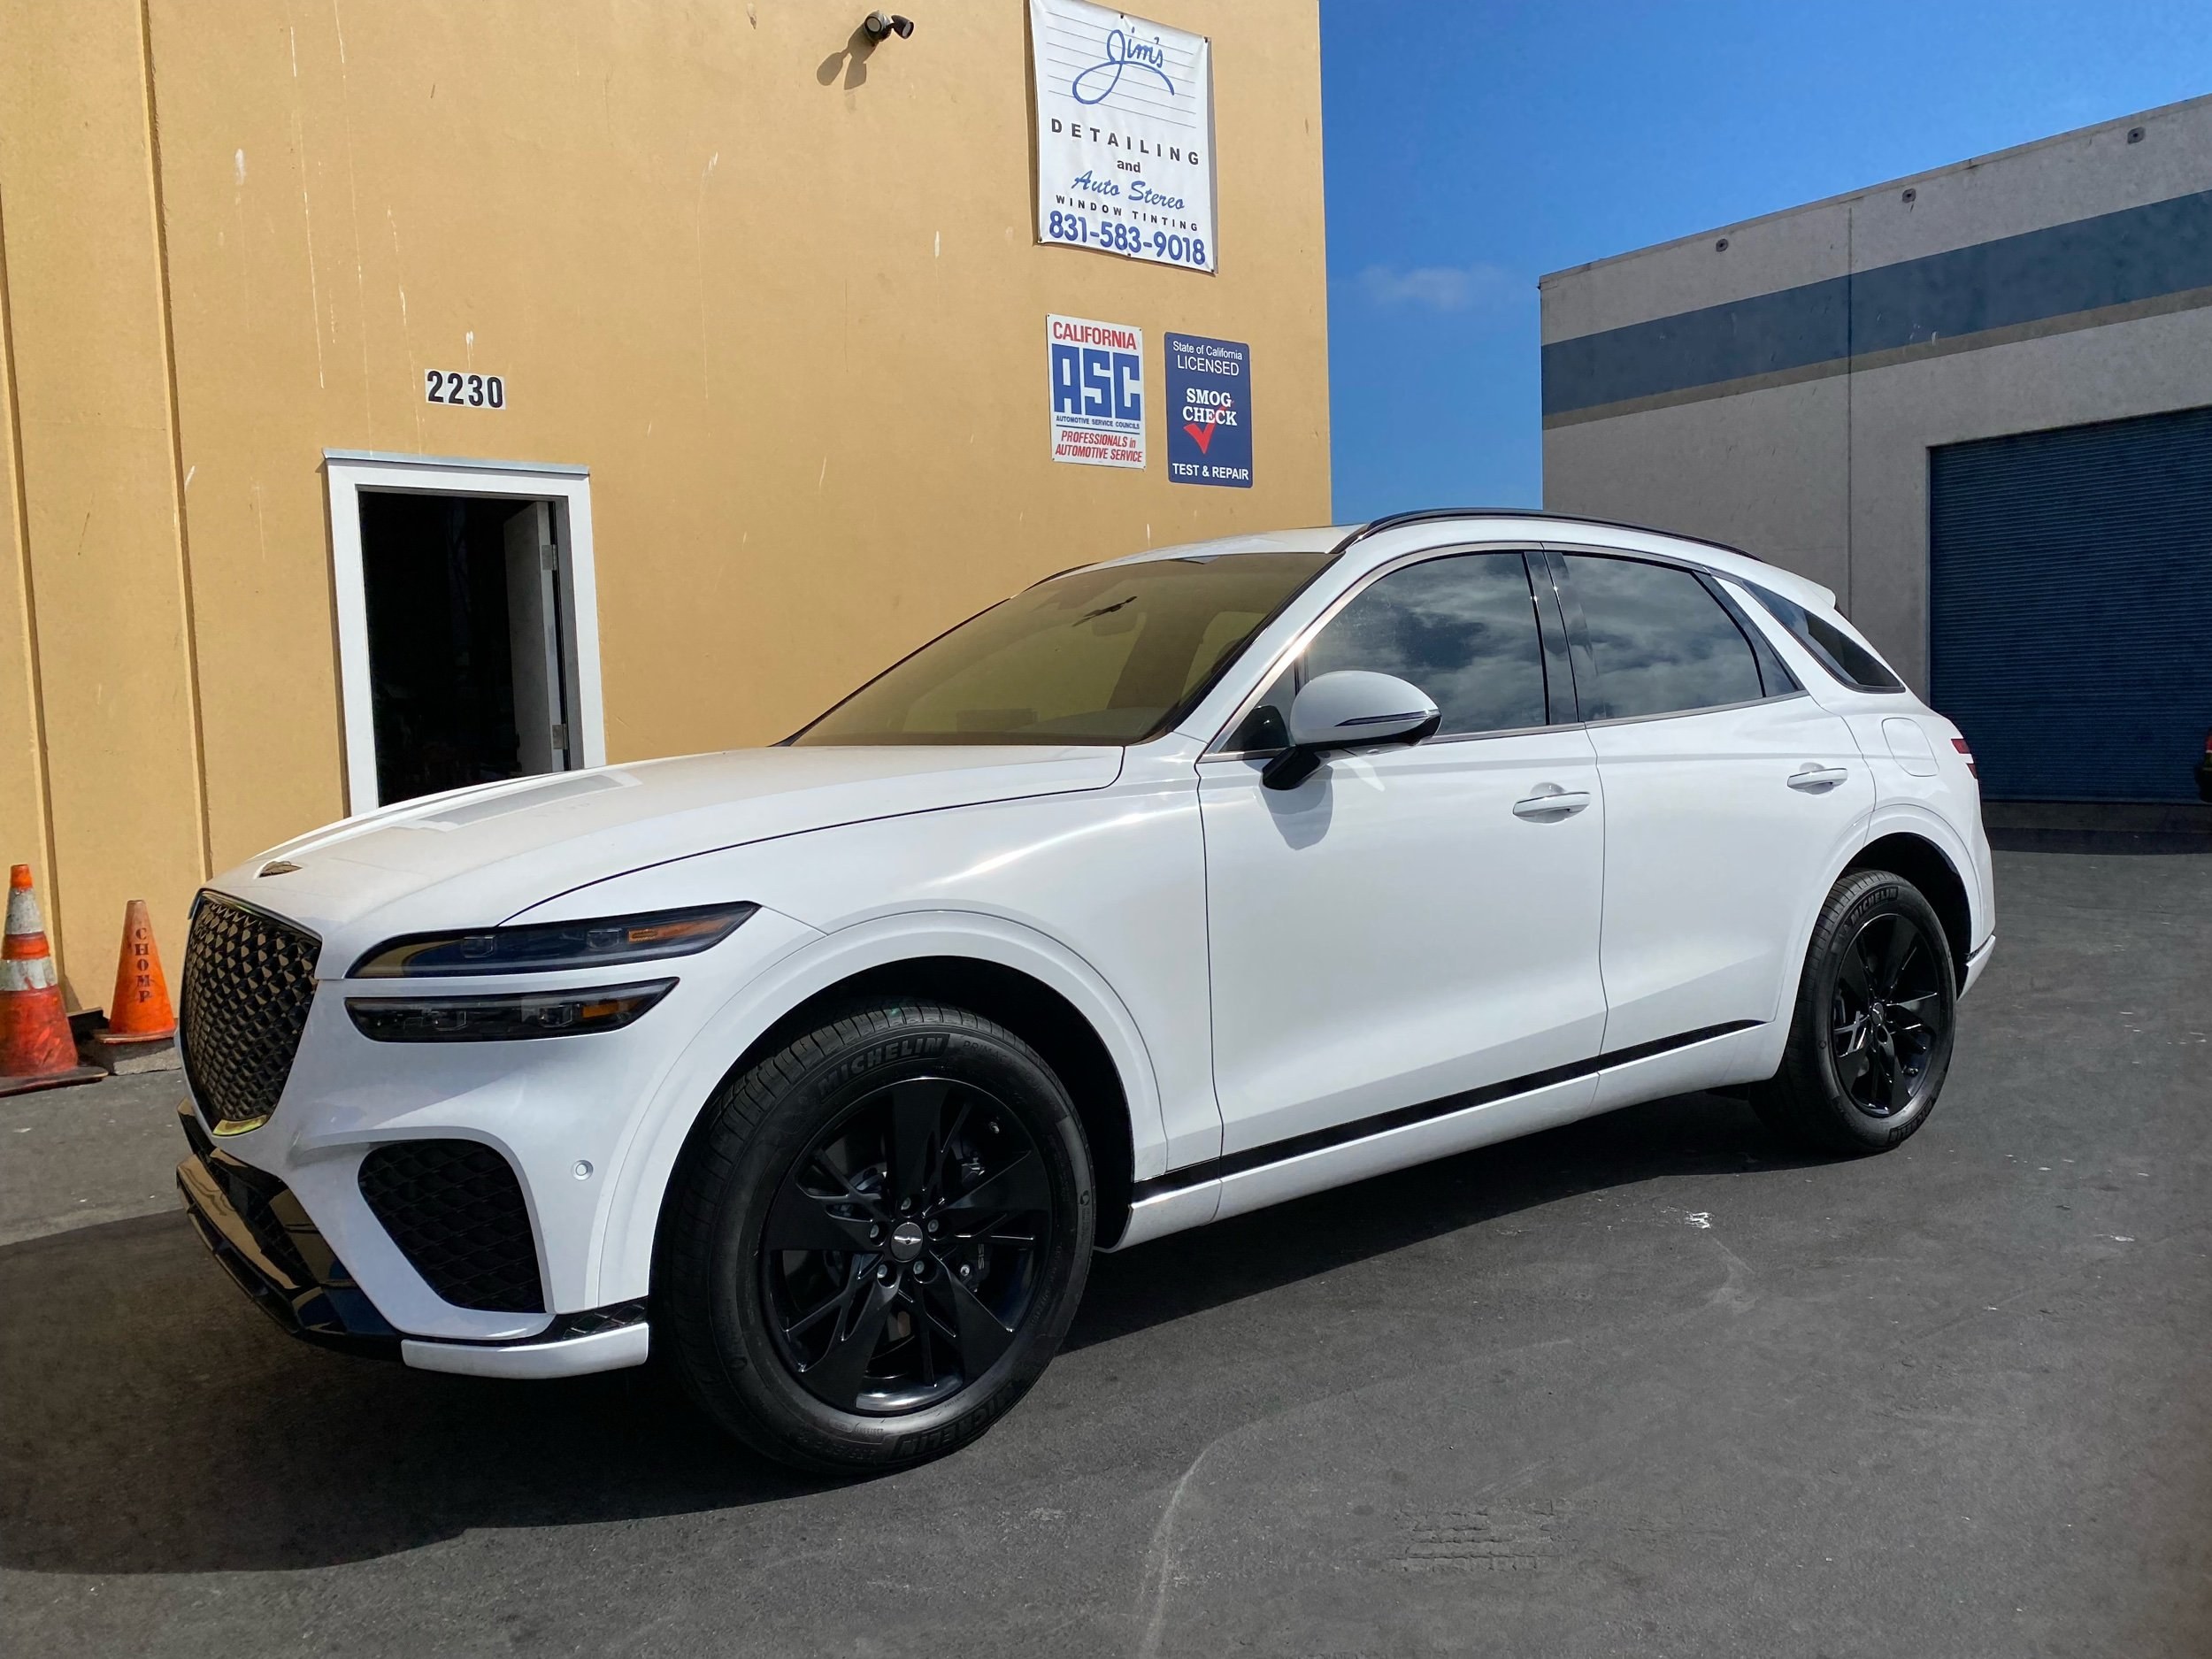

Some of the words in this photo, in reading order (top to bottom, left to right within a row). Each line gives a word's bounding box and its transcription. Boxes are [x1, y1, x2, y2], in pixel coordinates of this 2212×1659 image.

[1071, 27, 1175, 104] Jim's
[1050, 118, 1200, 165] DETAILING
[1117, 158, 1141, 173] and
[1071, 169, 1121, 196] Auto
[1128, 180, 1186, 210] Stereo
[1056, 194, 1123, 217] WINDOW
[1132, 211, 1198, 232] TINTING
[1048, 210, 1206, 265] 831-583-9018
[1053, 321, 1137, 350] CALIFORNIA
[1172, 341, 1194, 354] State
[1195, 344, 1205, 355] of
[1205, 345, 1243, 360] California
[1177, 354, 1240, 376] LICENSED
[426, 370, 503, 409] 2230
[1051, 342, 1141, 422] ASC
[1186, 388, 1233, 408] SMOG
[1056, 415, 1090, 425] AUTOMOTIVE
[1091, 419, 1114, 427] SERVICE
[1115, 421, 1141, 430] COUNCILS
[1182, 405, 1238, 426] CHECK
[1055, 444, 1109, 459] AUTOMOTIVE
[1110, 449, 1142, 463] SERVICE
[1061, 430, 1128, 448] PROFESSIONALS
[1130, 437, 1136, 449] in
[1172, 463, 1200, 477] TEST
[1202, 465, 1210, 478] &
[1212, 467, 1249, 480] REPAIR
[1850, 888, 1897, 926] MICHELIN
[134, 927, 152, 1003] CHOMP
[817, 1036, 943, 1097] MICHELIN
